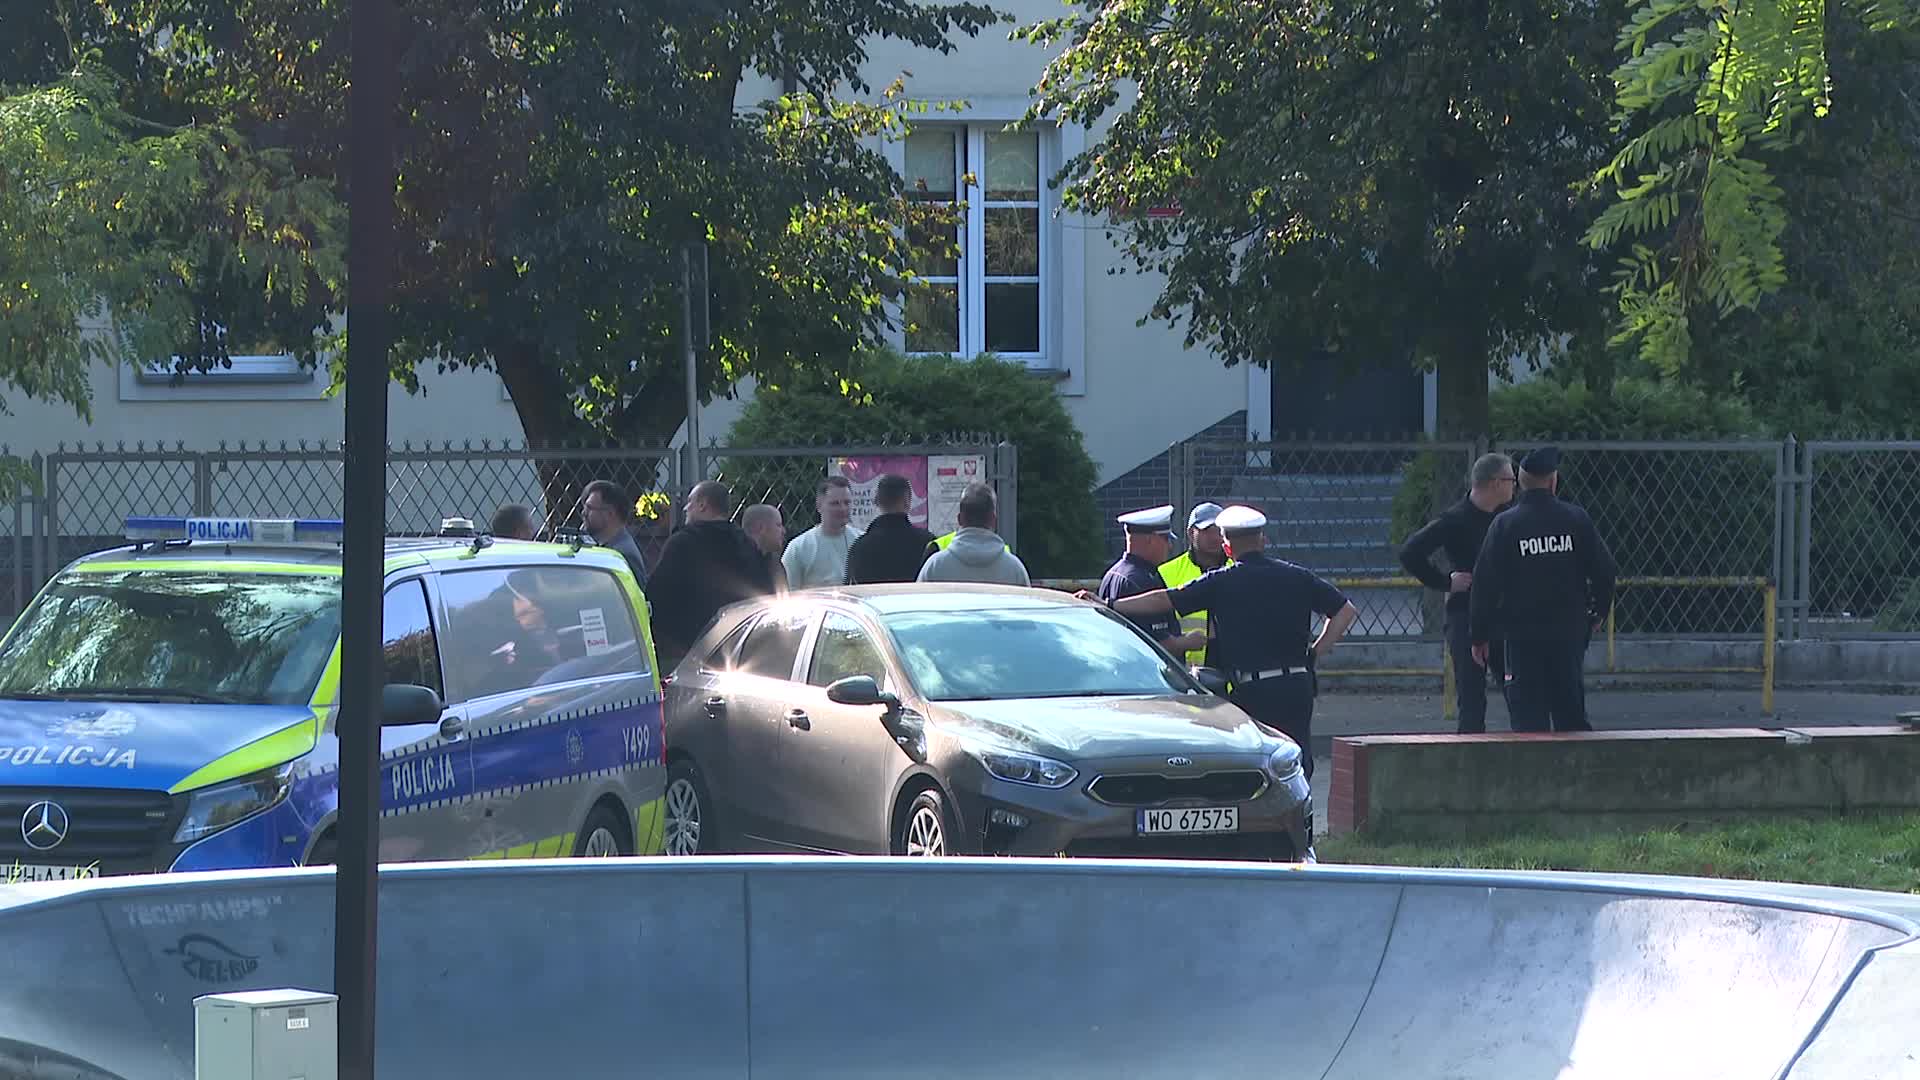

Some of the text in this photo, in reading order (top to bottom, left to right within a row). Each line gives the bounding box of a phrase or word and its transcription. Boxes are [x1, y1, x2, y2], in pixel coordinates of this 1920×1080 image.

[188, 521, 250, 539] POLICJA
[1519, 535, 1574, 556] POLICJA
[622, 724, 650, 760] Y499
[392, 754, 455, 800] POLICJA
[1149, 809, 1233, 831] WO 67575
